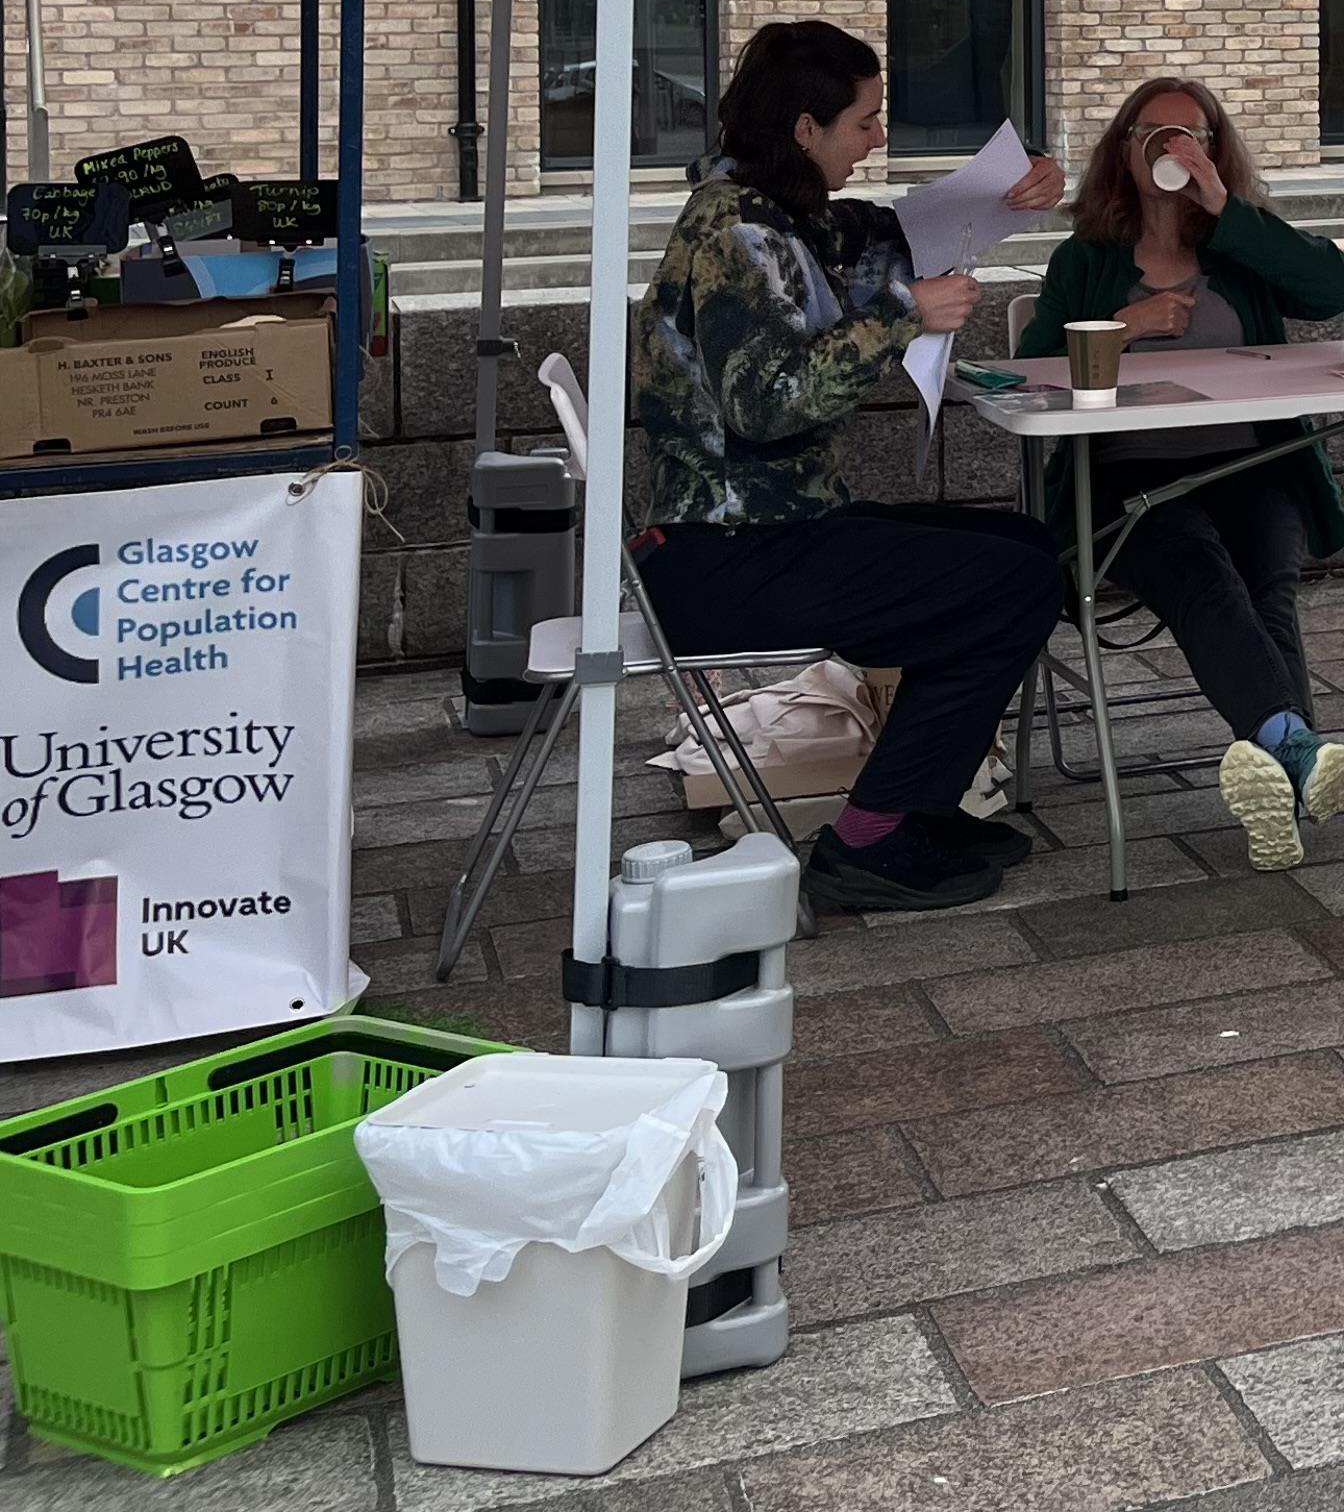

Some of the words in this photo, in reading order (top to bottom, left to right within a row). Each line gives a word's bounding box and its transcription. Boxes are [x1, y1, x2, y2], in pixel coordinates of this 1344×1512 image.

[83, 154, 127, 175] Mixed
[134, 142, 178, 161] Peppers
[32, 185, 96, 206] Cabbage
[250, 184, 320, 199] Turnip
[273, 216, 299, 229] UK
[50, 225, 73, 239] UK
[57, 361, 71, 371] H.
[74, 357, 122, 369] BAXTER
[125, 356, 135, 366] &
[138, 352, 173, 364] SONS
[199, 356, 257, 370] PRODUCE
[201, 348, 255, 360] ENGLISH
[68, 373, 89, 384] 196
[91, 370, 125, 382] MOSS
[128, 367, 157, 379] LANE
[203, 373, 241, 384] CLASS
[71, 384, 120, 396] HESKETH
[122, 380, 155, 392] BANK
[99, 393, 151, 406] PRESTON
[204, 399, 248, 411] COUNT
[92, 408, 112, 419] PR4
[115, 406, 137, 417] 6AE
[117, 538, 259, 569] Glasgow
[117, 578, 231, 604] Centre
[240, 567, 291, 594] for
[117, 606, 298, 647] Population
[117, 643, 229, 681] Health
[0, 711, 296, 779] University
[1, 775, 60, 839] of
[57, 768, 295, 821] Glasgow
[141, 891, 292, 924] Innovate
[141, 929, 190, 957] UK
